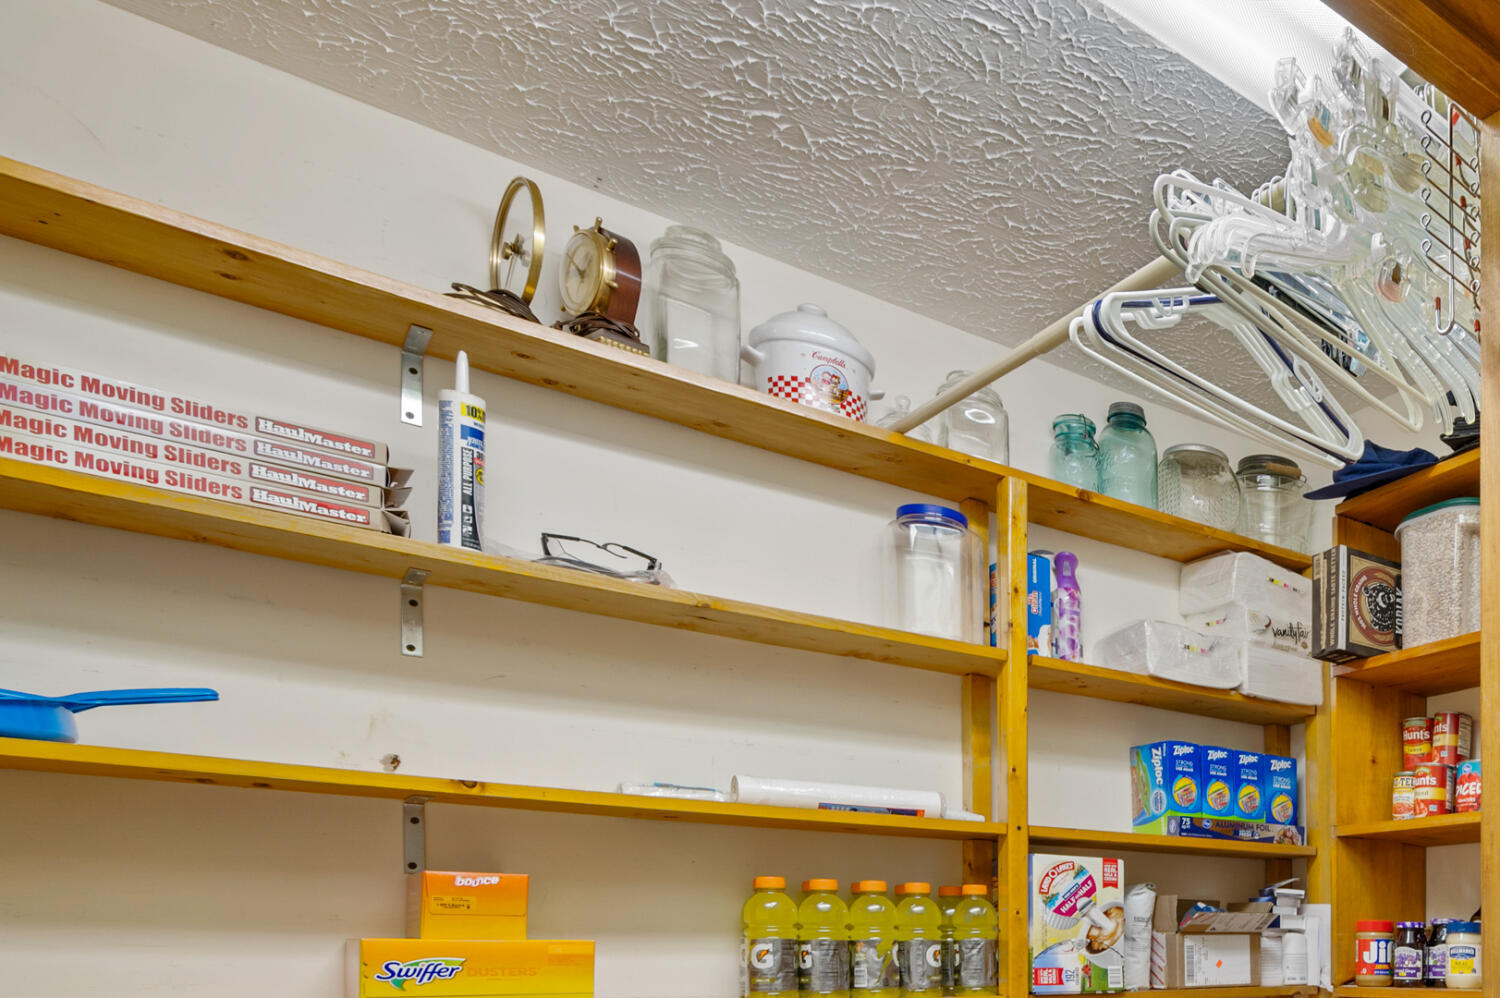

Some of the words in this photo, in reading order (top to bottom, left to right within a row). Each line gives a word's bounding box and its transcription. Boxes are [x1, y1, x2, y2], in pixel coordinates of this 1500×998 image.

[0, 355, 75, 389] Magic
[81, 376, 165, 412] Moving
[171, 397, 248, 430] Sliders
[257, 417, 373, 457] HaulMaster
[0, 383, 73, 414] Magic
[80, 401, 163, 436] Moving
[169, 423, 247, 453] Sliders
[256, 441, 372, 480] HaulMaster
[74, 427, 158, 460] Moving
[164, 446, 242, 476] Sliders
[250, 464, 367, 503] HaulMaster
[462, 448, 473, 482] PURPOSE
[75, 452, 159, 485] Moving
[165, 470, 243, 501] Sliders
[252, 487, 369, 525] HaulMaster
[462, 482, 473, 496] ALL
[1173, 745, 1195, 756] Ziploc
[1207, 750, 1229, 760] Ziploc
[1239, 754, 1259, 765] Ziploc
[1151, 746, 1164, 785] Ziploc
[1270, 760, 1292, 772] Ziploc
[1255, 824, 1271, 832] FOIL
[455, 875, 500, 887] bounce
[1060, 896, 1077, 914] HALF
[1080, 880, 1093, 897] HALF
[751, 943, 773, 970] G
[376, 961, 461, 984] Swiffer
[467, 967, 538, 977] DUSTERS
